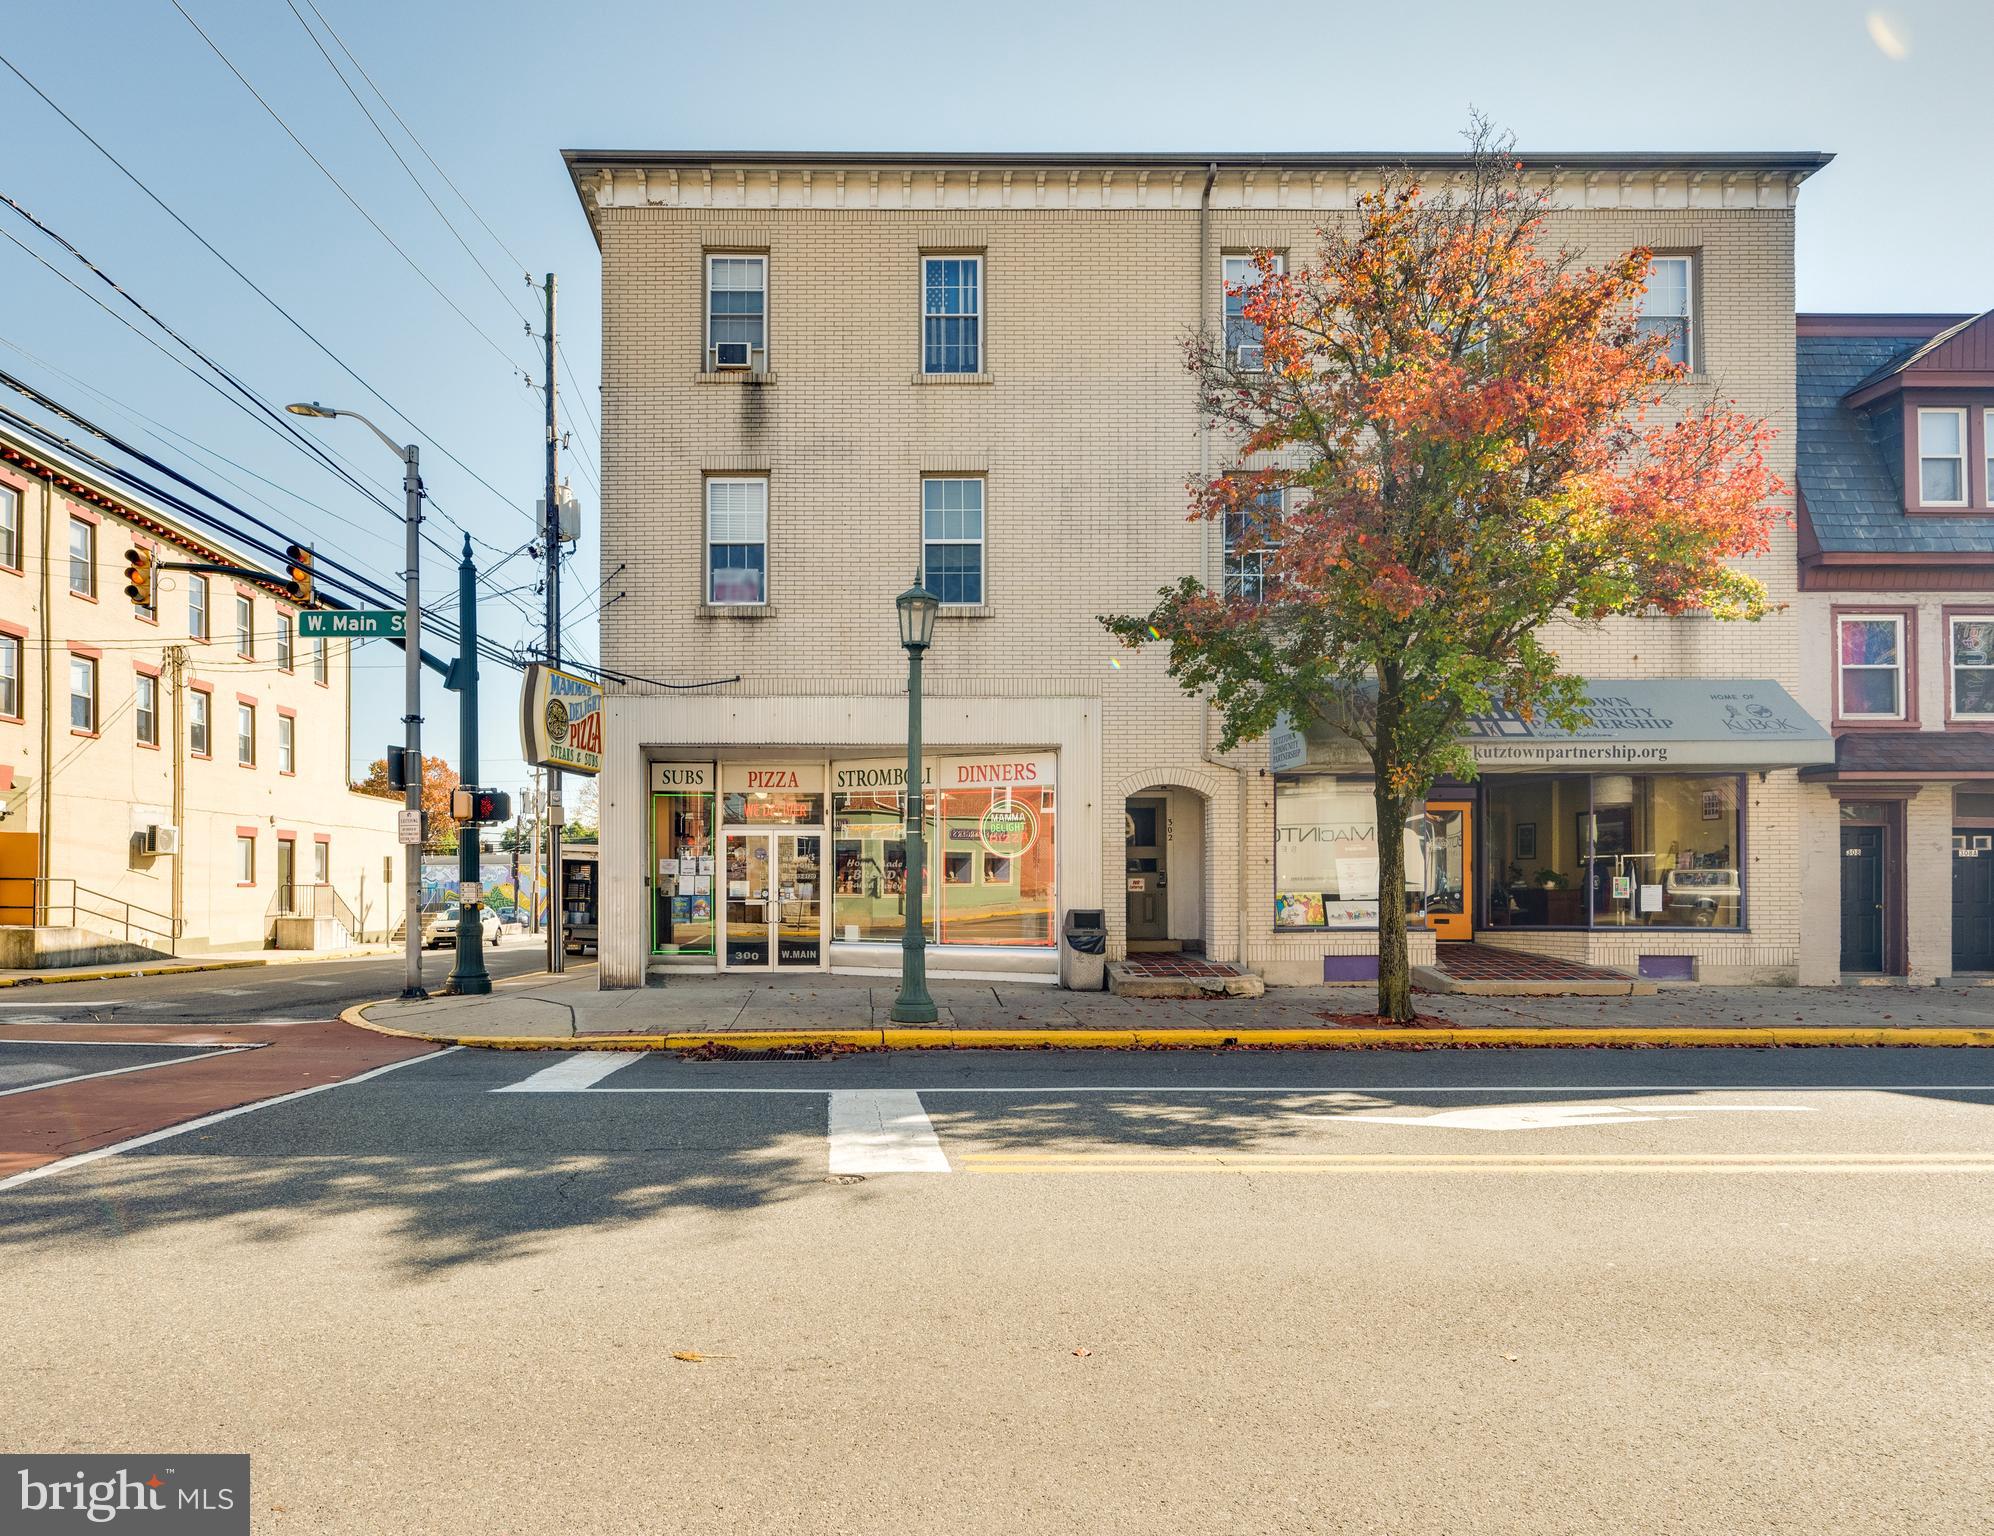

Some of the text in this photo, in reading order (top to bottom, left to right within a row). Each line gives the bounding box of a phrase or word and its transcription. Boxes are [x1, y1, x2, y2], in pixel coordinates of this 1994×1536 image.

[307, 615, 326, 631] W.
[333, 615, 377, 631] Main
[568, 694, 601, 722] DELIGHT
[569, 711, 602, 754] PIZZA
[550, 744, 574, 762] STEAKS
[584, 752, 599, 768] SUBS
[1473, 745, 1668, 762] kutztownpartnership.org
[662, 769, 704, 785] SUBS
[747, 771, 799, 788] PIZZA
[837, 767, 932, 788] STROMBI
[957, 762, 1037, 783] DINNERS
[990, 813, 1026, 822] MAMMA
[990, 822, 1026, 833] DELIGHT
[735, 950, 817, 961] 300 W.MAIN
